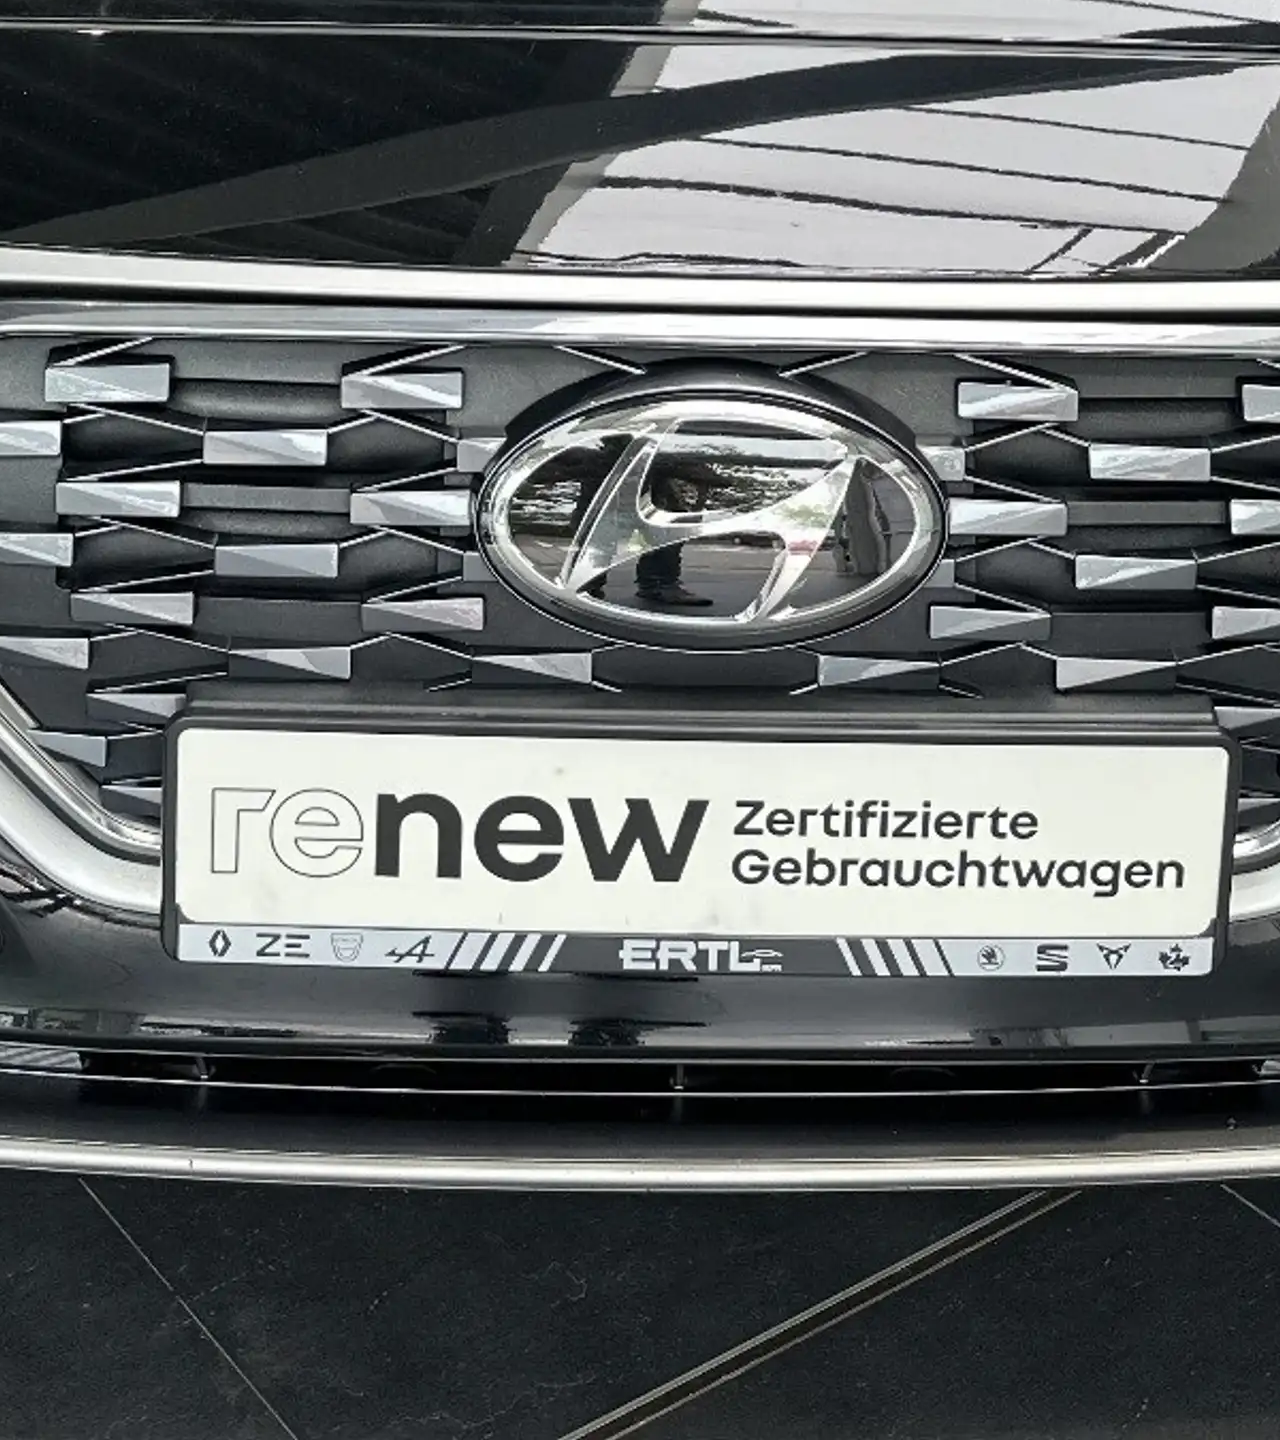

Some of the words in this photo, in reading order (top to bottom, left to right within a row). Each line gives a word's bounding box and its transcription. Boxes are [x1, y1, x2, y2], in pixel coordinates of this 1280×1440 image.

[211, 787, 710, 882] renew
[733, 799, 1039, 840] Zertifizierte
[731, 847, 1186, 898] Gebrauchtwagen
[618, 938, 762, 973] ERTL
